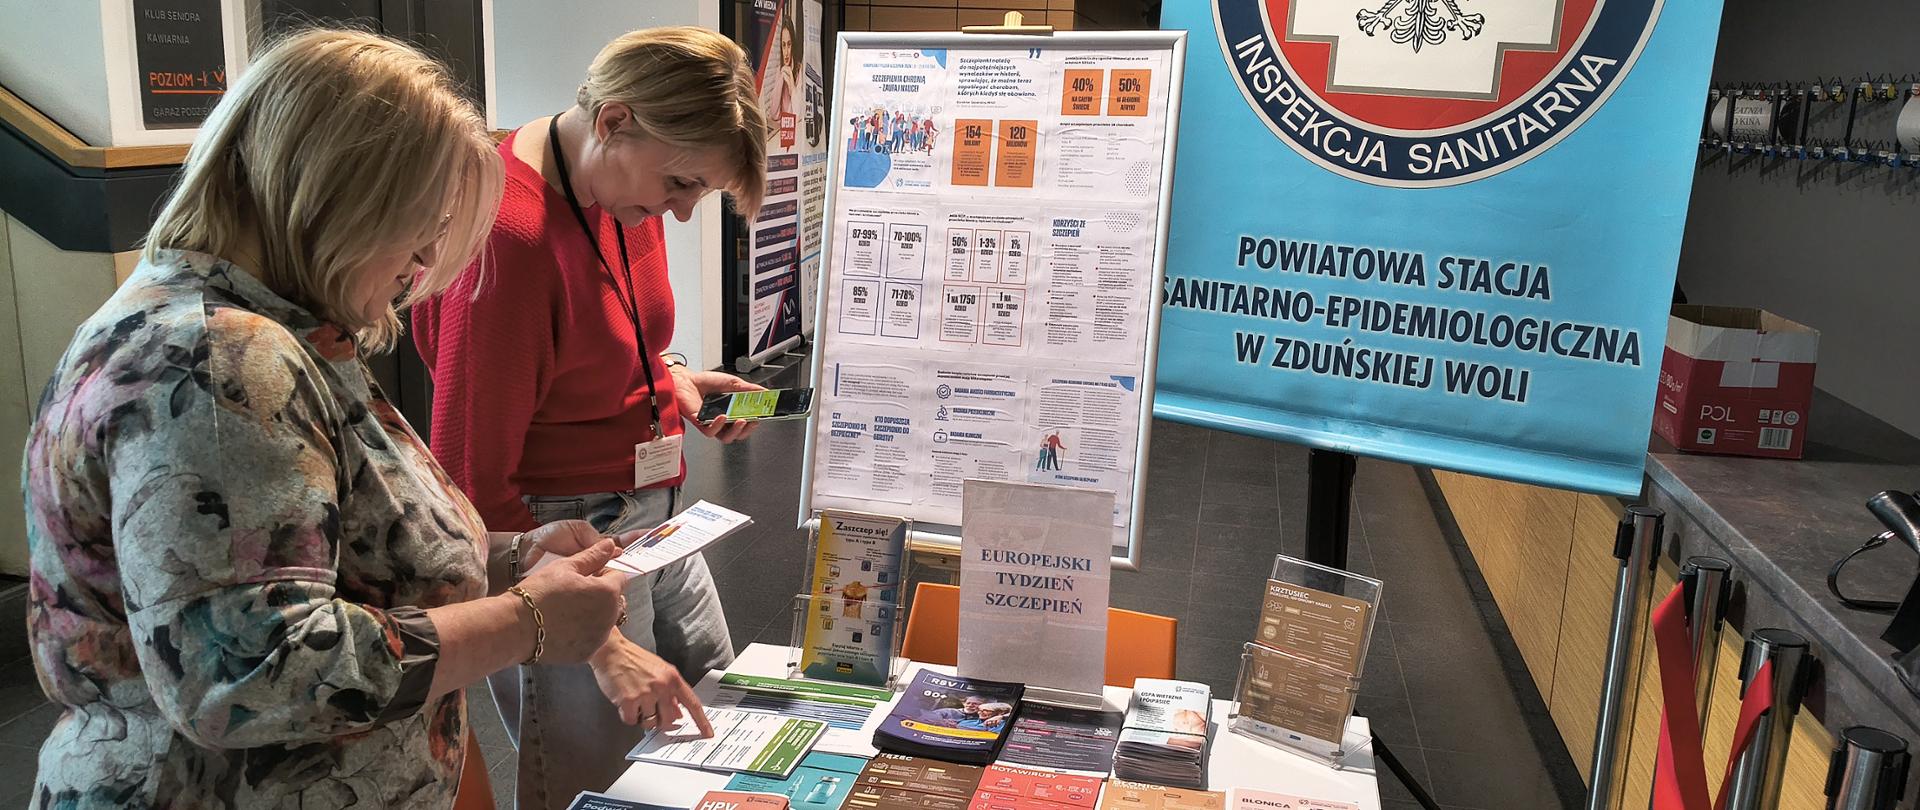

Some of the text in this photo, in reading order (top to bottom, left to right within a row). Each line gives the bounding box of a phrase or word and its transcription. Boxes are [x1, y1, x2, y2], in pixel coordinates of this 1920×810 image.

[145, 9, 201, 22] KLUB SENIORA
[146, 33, 190, 44] KAWIARNIA
[149, 72, 194, 87] POZIOM
[872, 74, 926, 84] SZCZEPIENIA CHRONIĄ
[1072, 78, 1094, 92] 40%
[1118, 78, 1141, 92] 50%
[1235, 33, 1388, 172] INSPEKCJA
[1408, 54, 1618, 174] SANITARNA
[1740, 118, 1761, 126] KINA
[965, 125, 982, 138] 154
[1010, 126, 1026, 140] 120
[1052, 218, 1086, 228] KORZYŚCI ZE
[852, 228, 878, 240] 87-99%
[894, 231, 922, 242] 70-100%
[1052, 228, 1080, 238] SZCZEPIEŃ
[952, 236, 968, 247] 50%
[980, 238, 996, 248] 1-3%
[1010, 240, 1020, 250] 1%
[1238, 236, 1550, 301] POWIATOWA STACJA
[852, 286, 868, 298] 85%
[891, 288, 914, 300] 71-78%
[946, 293, 950, 304] 1
[960, 294, 976, 304] 1750
[1162, 276, 1641, 367] SANITARNO-EPIDEMIOLOGICZNA
[1236, 332, 1529, 403] W ZDUŃSKIEJ WOLI
[832, 412, 842, 420] CZY
[1700, 404, 1736, 422] POL
[874, 416, 884, 424] KTO
[836, 522, 889, 536] Zaszczep się!
[981, 548, 1092, 572] EUROPEJSKI
[996, 572, 1074, 592] TYDZIEŃ
[1270, 585, 1310, 599] KRZTUSIEC
[985, 592, 1083, 614] SZCZEPIEŃ
[931, 677, 958, 688] RSV
[991, 765, 1059, 779] ROTAWIRUSY
[699, 800, 739, 810] HPV
